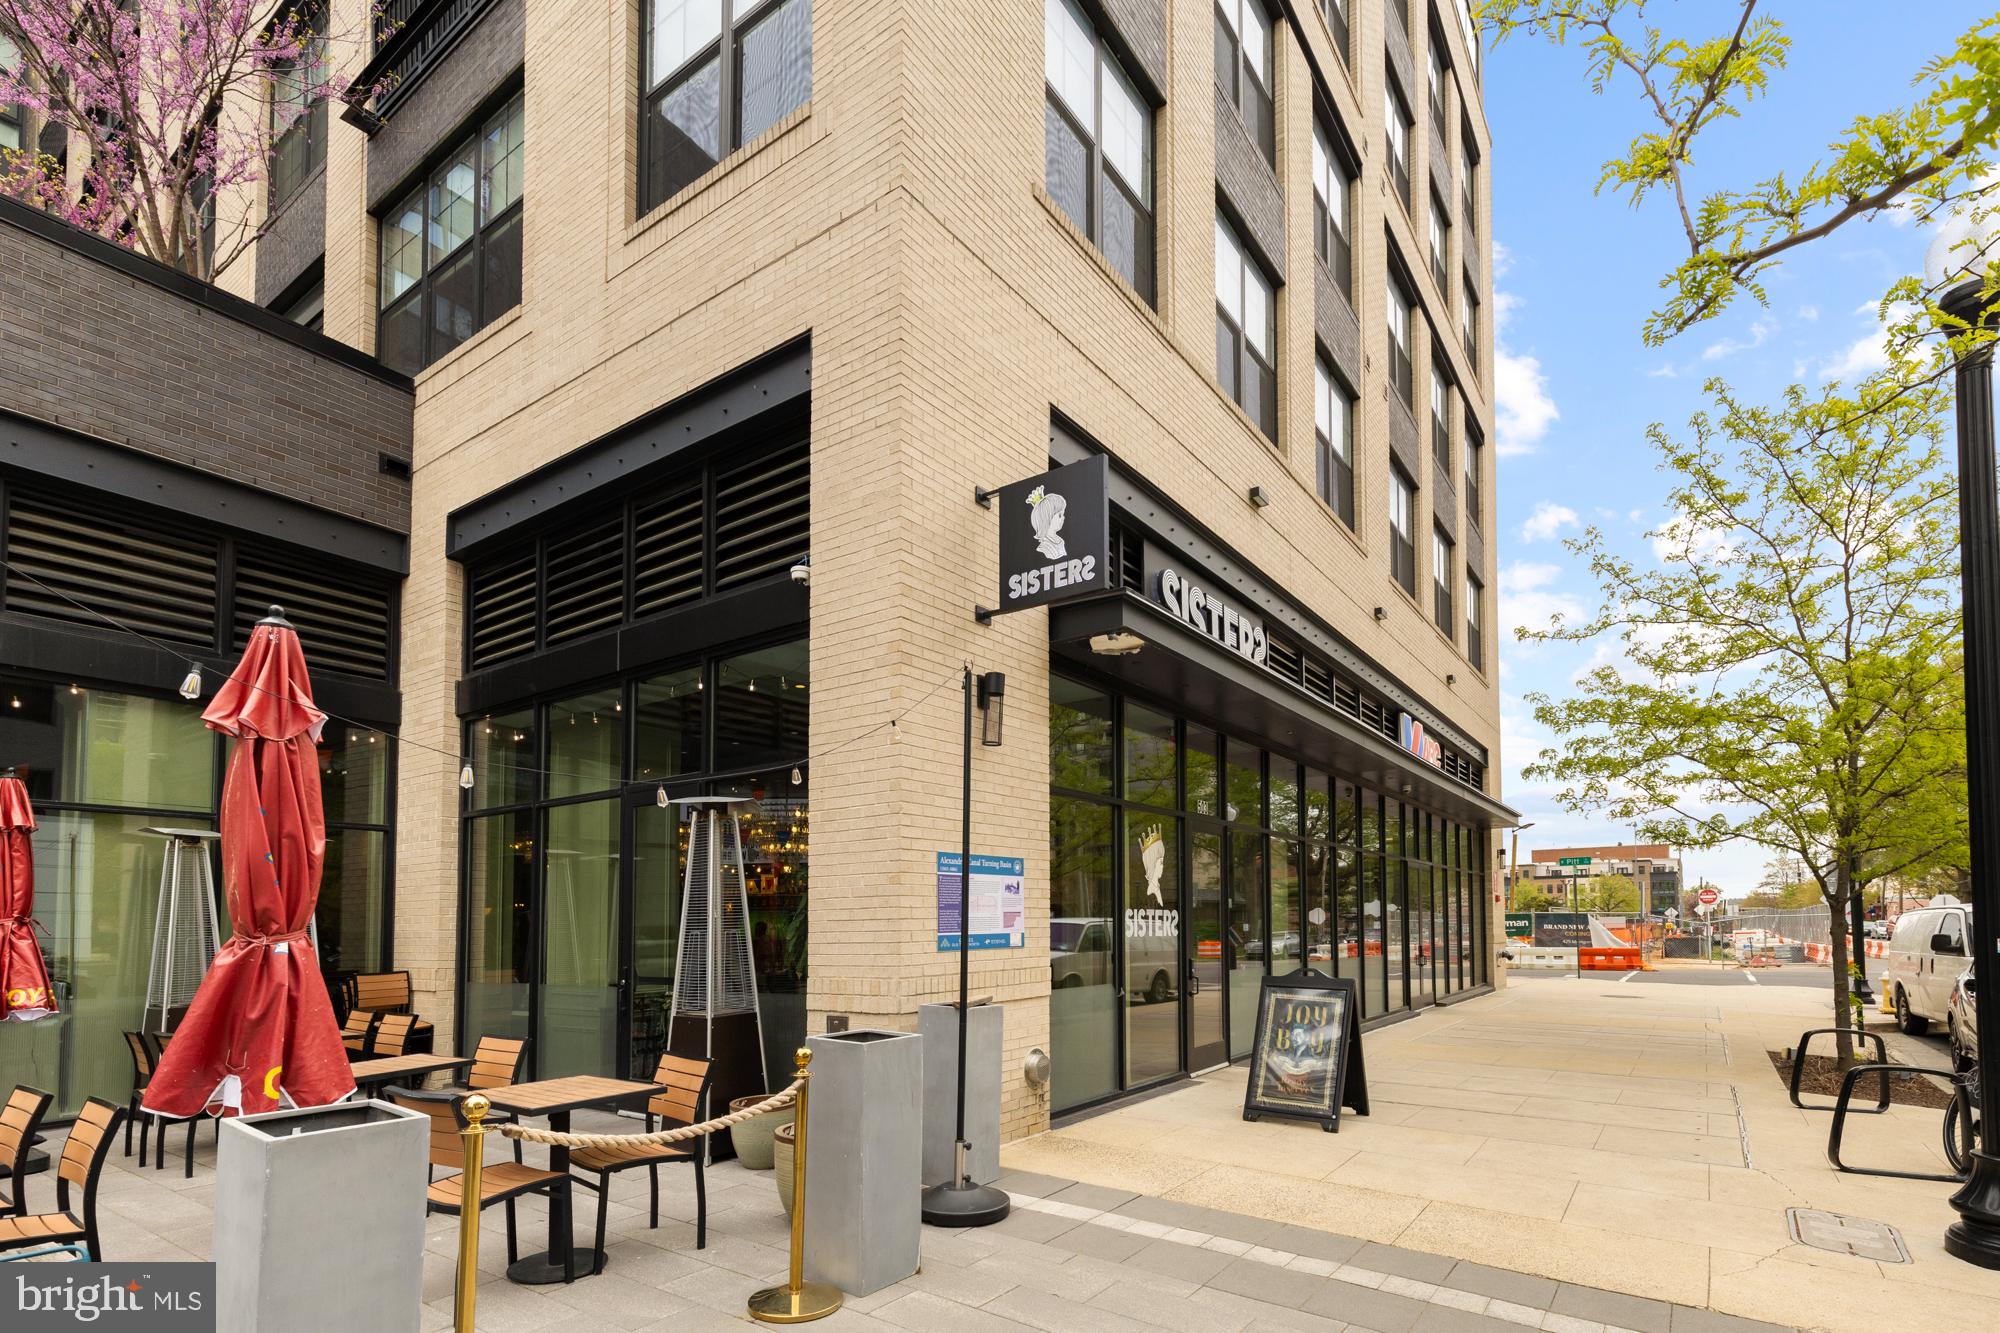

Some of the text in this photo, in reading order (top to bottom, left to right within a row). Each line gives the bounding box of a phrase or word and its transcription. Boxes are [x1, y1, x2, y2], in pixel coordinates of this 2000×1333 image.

[1008, 555, 1096, 599] SISTERS
[1160, 568, 1268, 664] SISTERS
[1125, 908, 1179, 938] SISTERS
[1281, 1003, 1328, 1027] JOY
